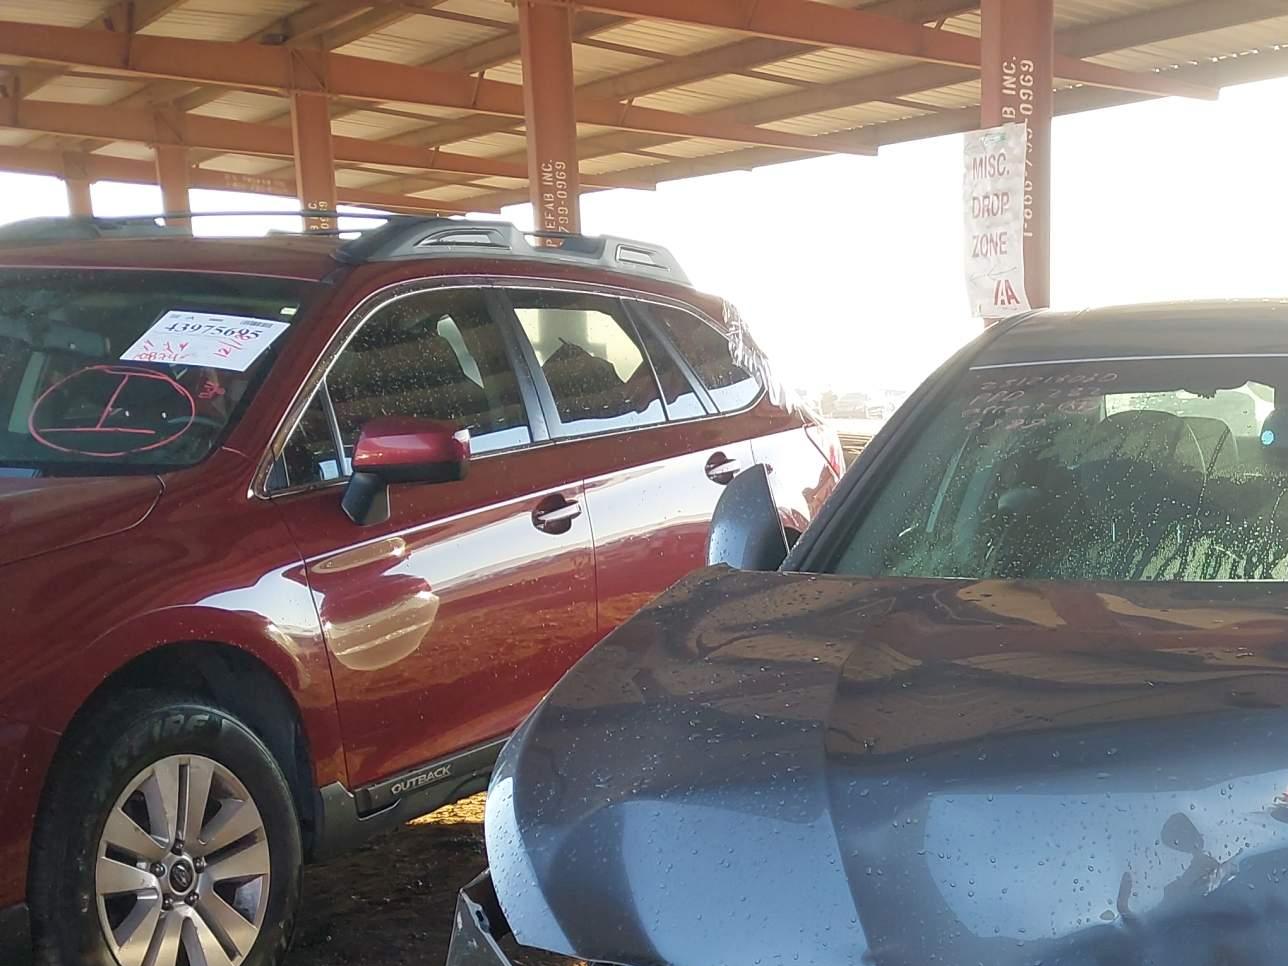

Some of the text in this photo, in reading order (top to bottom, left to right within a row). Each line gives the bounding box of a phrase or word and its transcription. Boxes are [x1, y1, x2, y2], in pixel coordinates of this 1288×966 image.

[1002, 56, 1017, 97] INC.
[972, 151, 1011, 181] MISC.
[541, 159, 557, 248] PEFAB INC.
[972, 191, 1010, 219] DROP
[972, 231, 1008, 259] ZONE
[391, 764, 452, 794] OUTBACK
